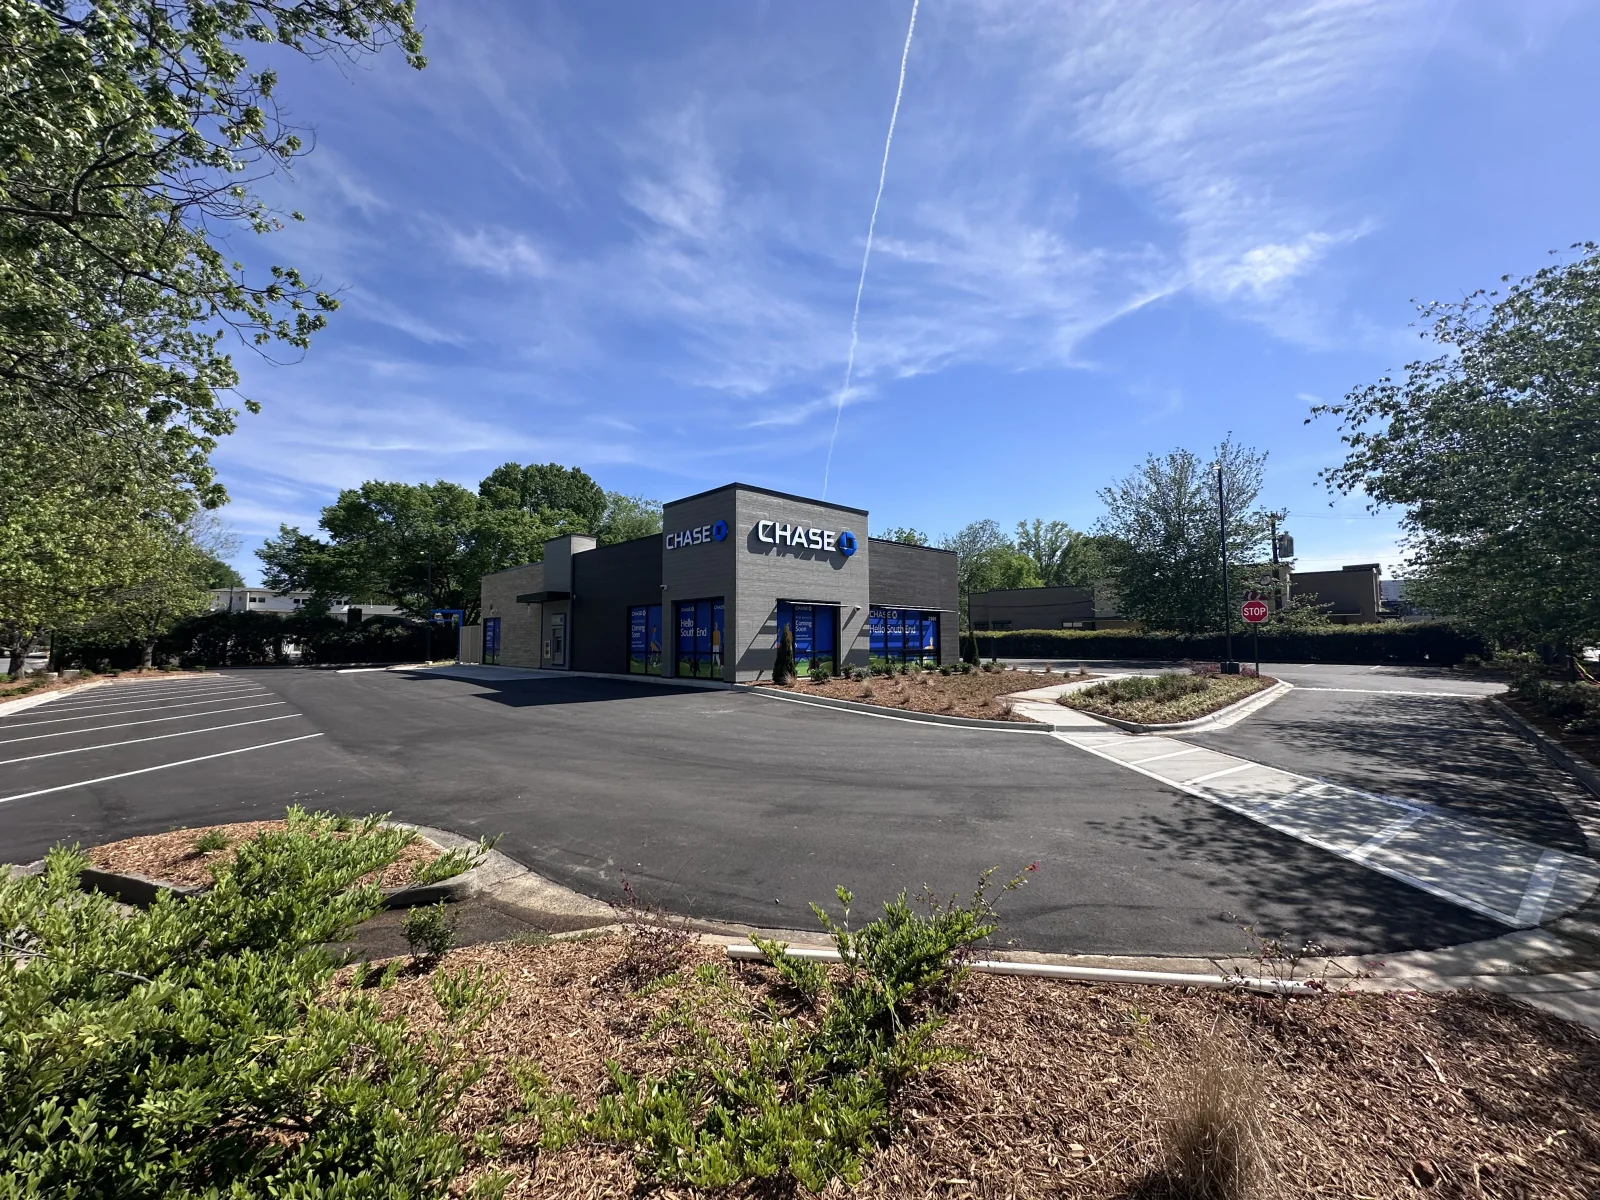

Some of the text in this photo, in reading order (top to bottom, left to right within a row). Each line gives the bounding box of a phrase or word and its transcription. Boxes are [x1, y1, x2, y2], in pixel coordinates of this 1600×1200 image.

[666, 525, 711, 550] CHASE
[758, 520, 836, 552] CHASE
[869, 610, 892, 618] CHASE
[1243, 607, 1266, 616] STOP
[681, 618, 694, 627] Hello
[795, 620, 812, 628] Coming
[697, 627, 707, 636] End
[869, 624, 916, 634] Hello South End
